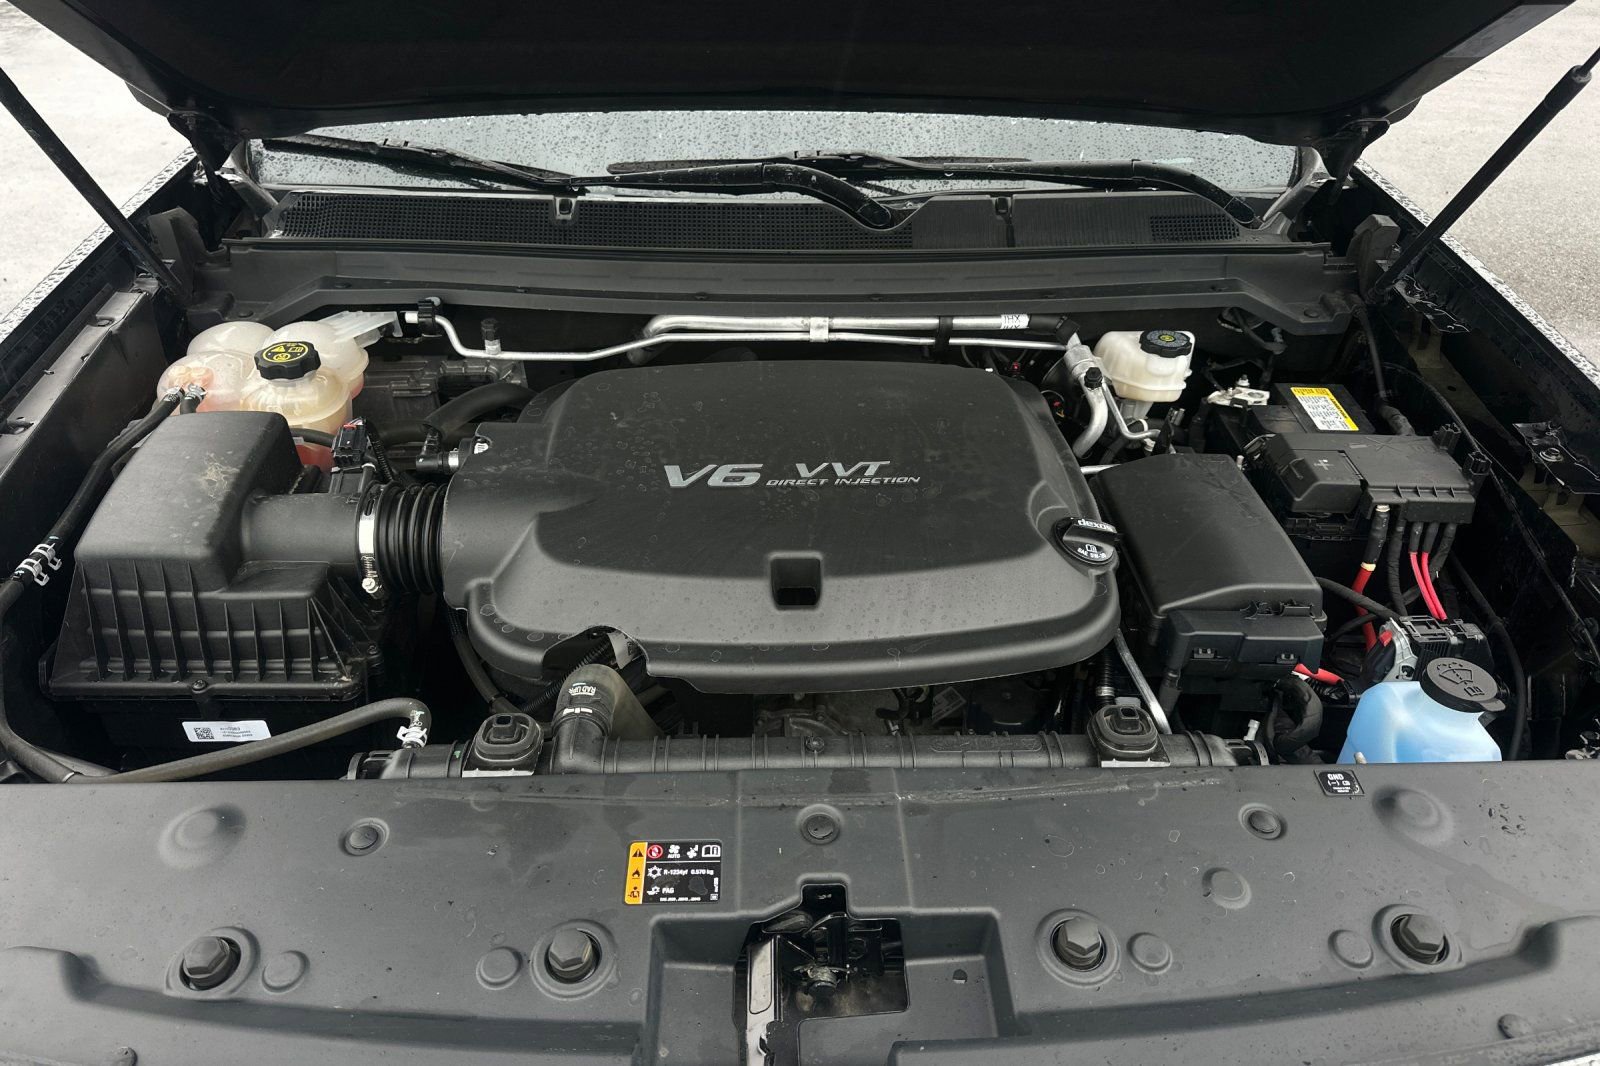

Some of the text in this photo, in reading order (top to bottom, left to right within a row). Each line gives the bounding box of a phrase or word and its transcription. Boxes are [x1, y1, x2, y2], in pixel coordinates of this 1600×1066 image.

[663, 460, 891, 488] V6 VVT
[765, 476, 921, 487] DIRECT INJECTION
